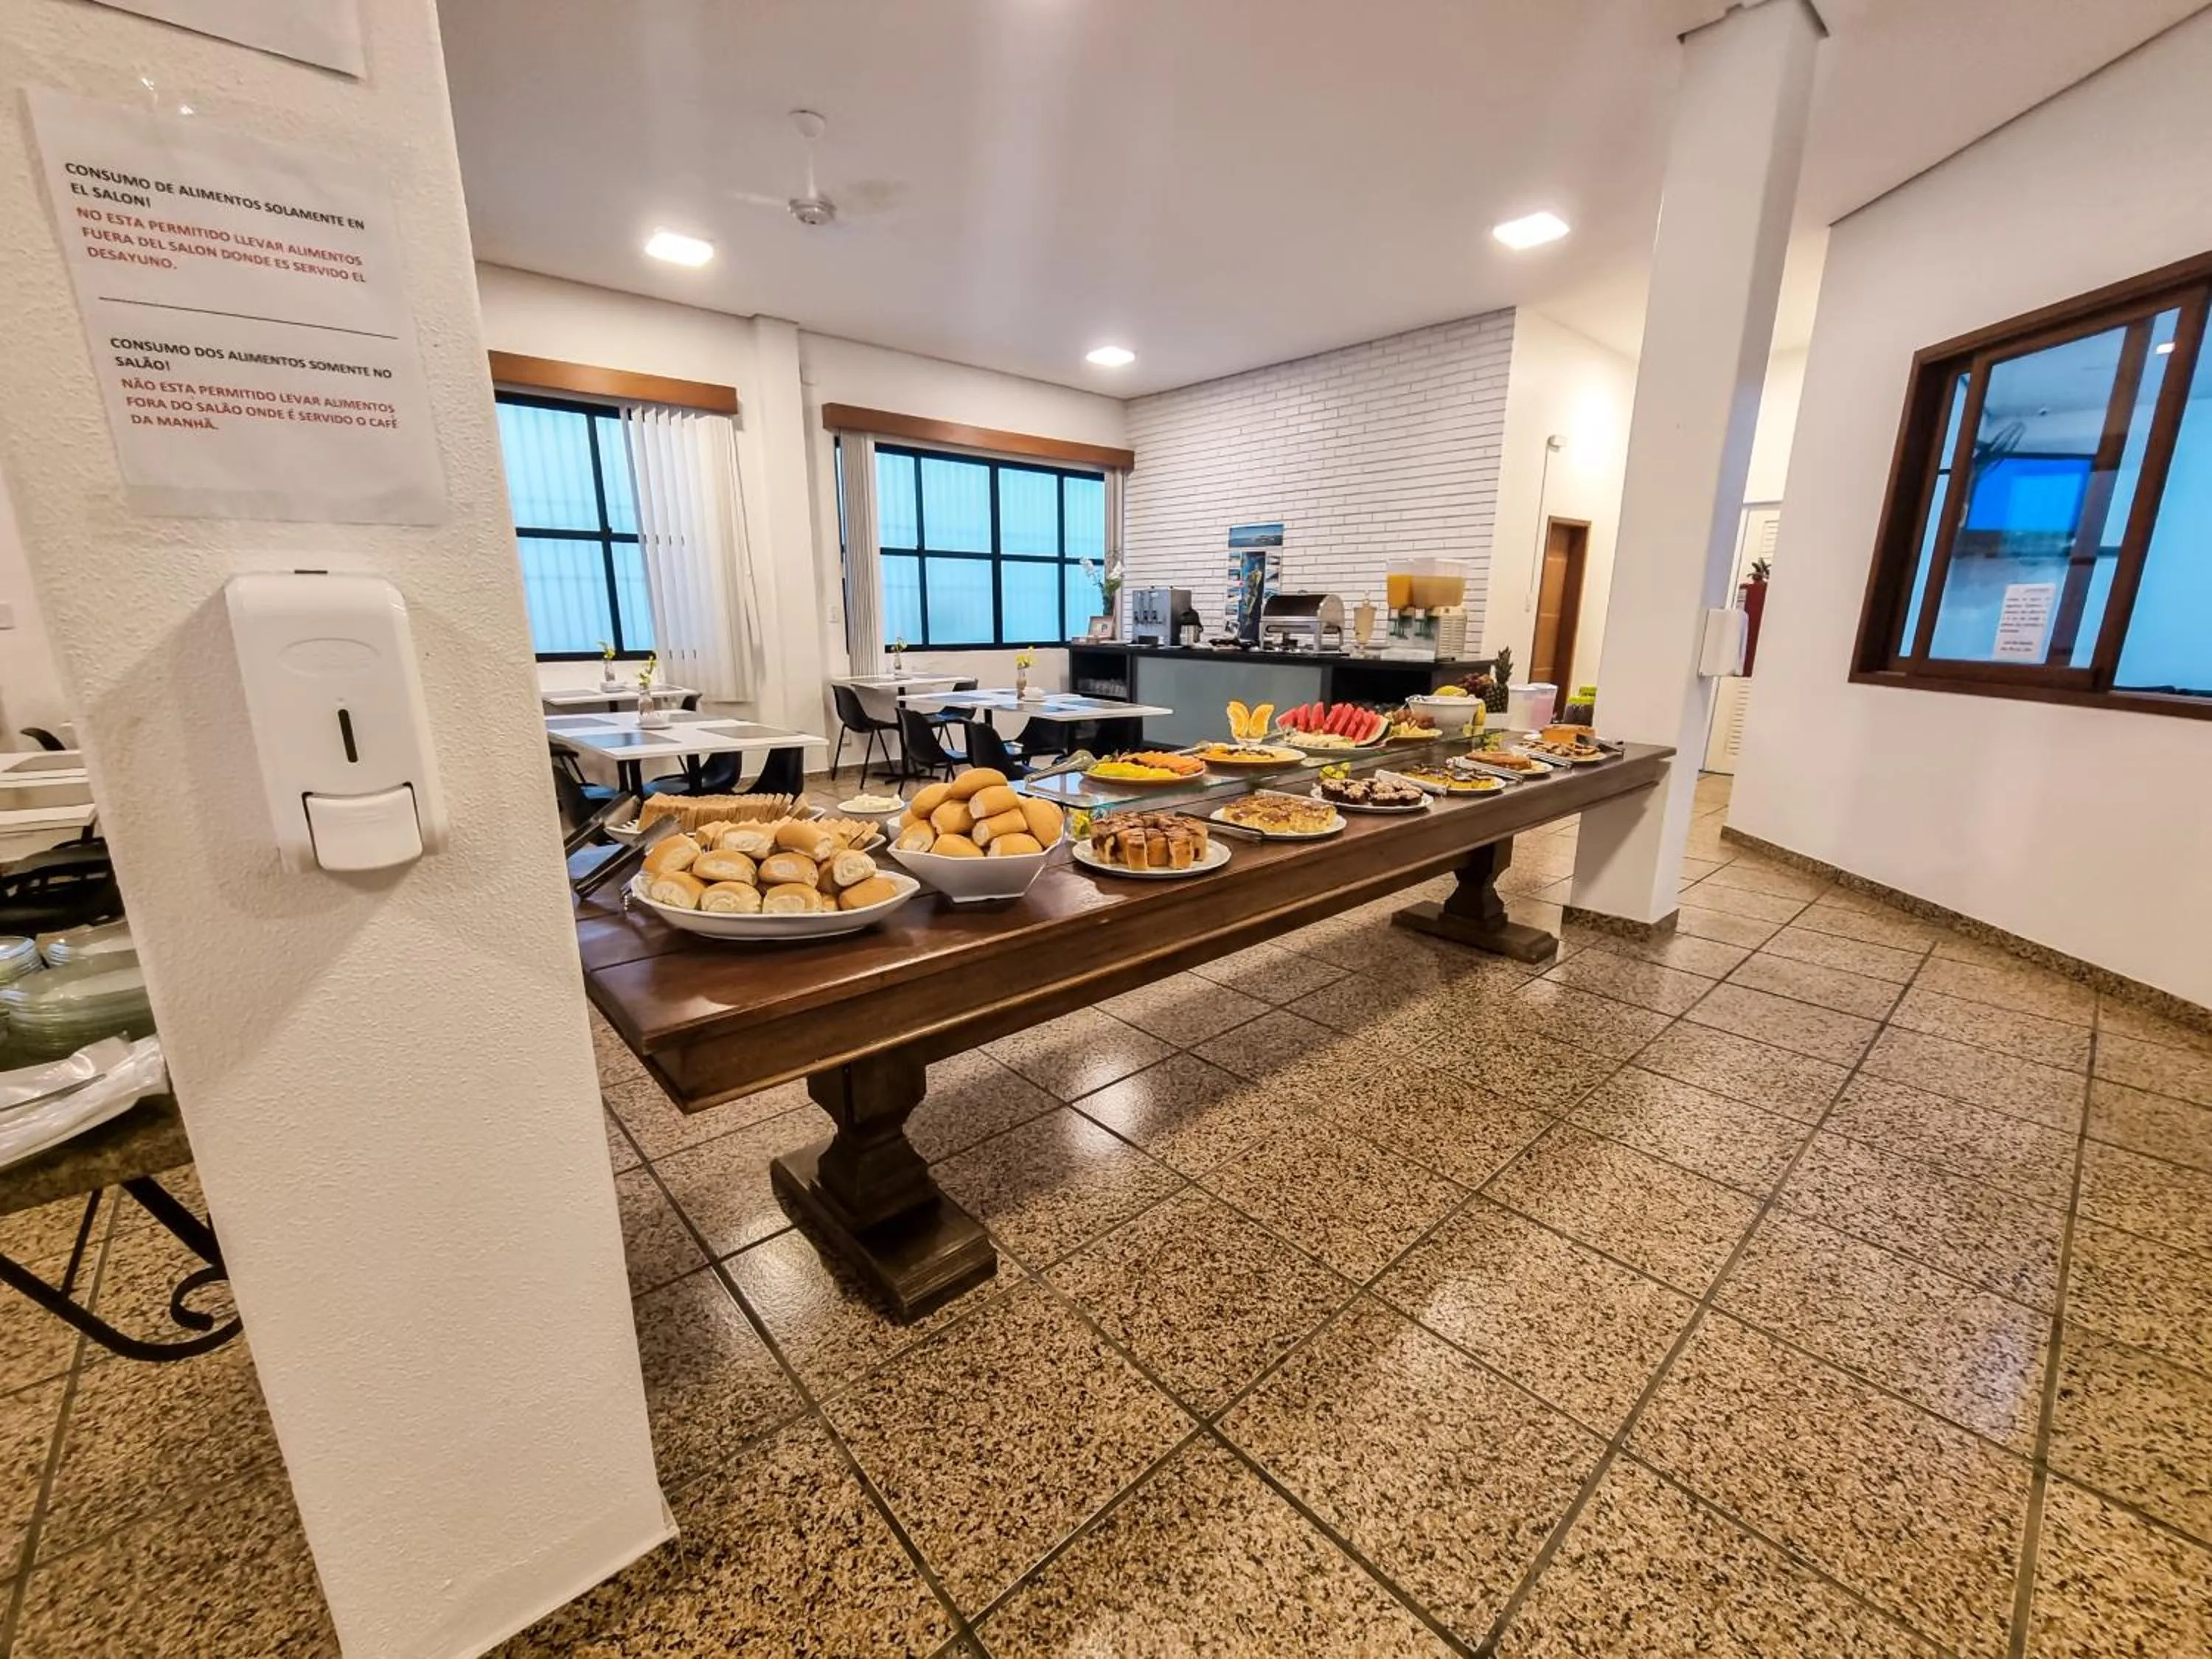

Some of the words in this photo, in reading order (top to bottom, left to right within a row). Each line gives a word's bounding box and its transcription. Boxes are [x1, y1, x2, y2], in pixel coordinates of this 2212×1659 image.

[65, 162, 150, 189] CONSUMO
[155, 181, 175, 195] DE
[179, 185, 261, 211] ALIMENTOS
[265, 202, 344, 227] SOLAMENTE
[347, 218, 364, 230] EN
[71, 182, 88, 196] EL
[77, 207, 101, 221] NO
[106, 213, 145, 229] ESTA
[149, 220, 230, 242] PERMITIDO
[234, 234, 283, 251] LLEVAR
[288, 244, 362, 266] ALIMENTOS
[83, 226, 133, 246] FUERA
[138, 237, 165, 250] DEL
[168, 241, 217, 257] SALON
[221, 248, 271, 266] DONDE
[275, 258, 289, 269] ES
[293, 262, 348, 279] SERVIDO
[352, 271, 366, 282] EL
[87, 246, 178, 270] DESAYUNO.
[111, 338, 190, 355] CONSUMO
[195, 347, 224, 358] DOS
[228, 351, 306, 368] ALIMENTOS
[310, 360, 370, 377] SOMENTE
[373, 368, 392, 378] NO
[121, 377, 156, 391] NÃO
[198, 386, 276, 402] PERMITIDO
[279, 392, 320, 406] LEVAR
[324, 398, 395, 414] ALIMENTOS
[126, 397, 167, 408] FORA
[170, 400, 192, 411] DO
[196, 402, 242, 415] SALÃO
[246, 406, 285, 419] ONDE
[288, 408, 295, 420] É
[299, 411, 352, 425] SERVIDO
[356, 417, 366, 426] O
[369, 415, 397, 429] CAFÉ
[131, 414, 153, 425] DA
